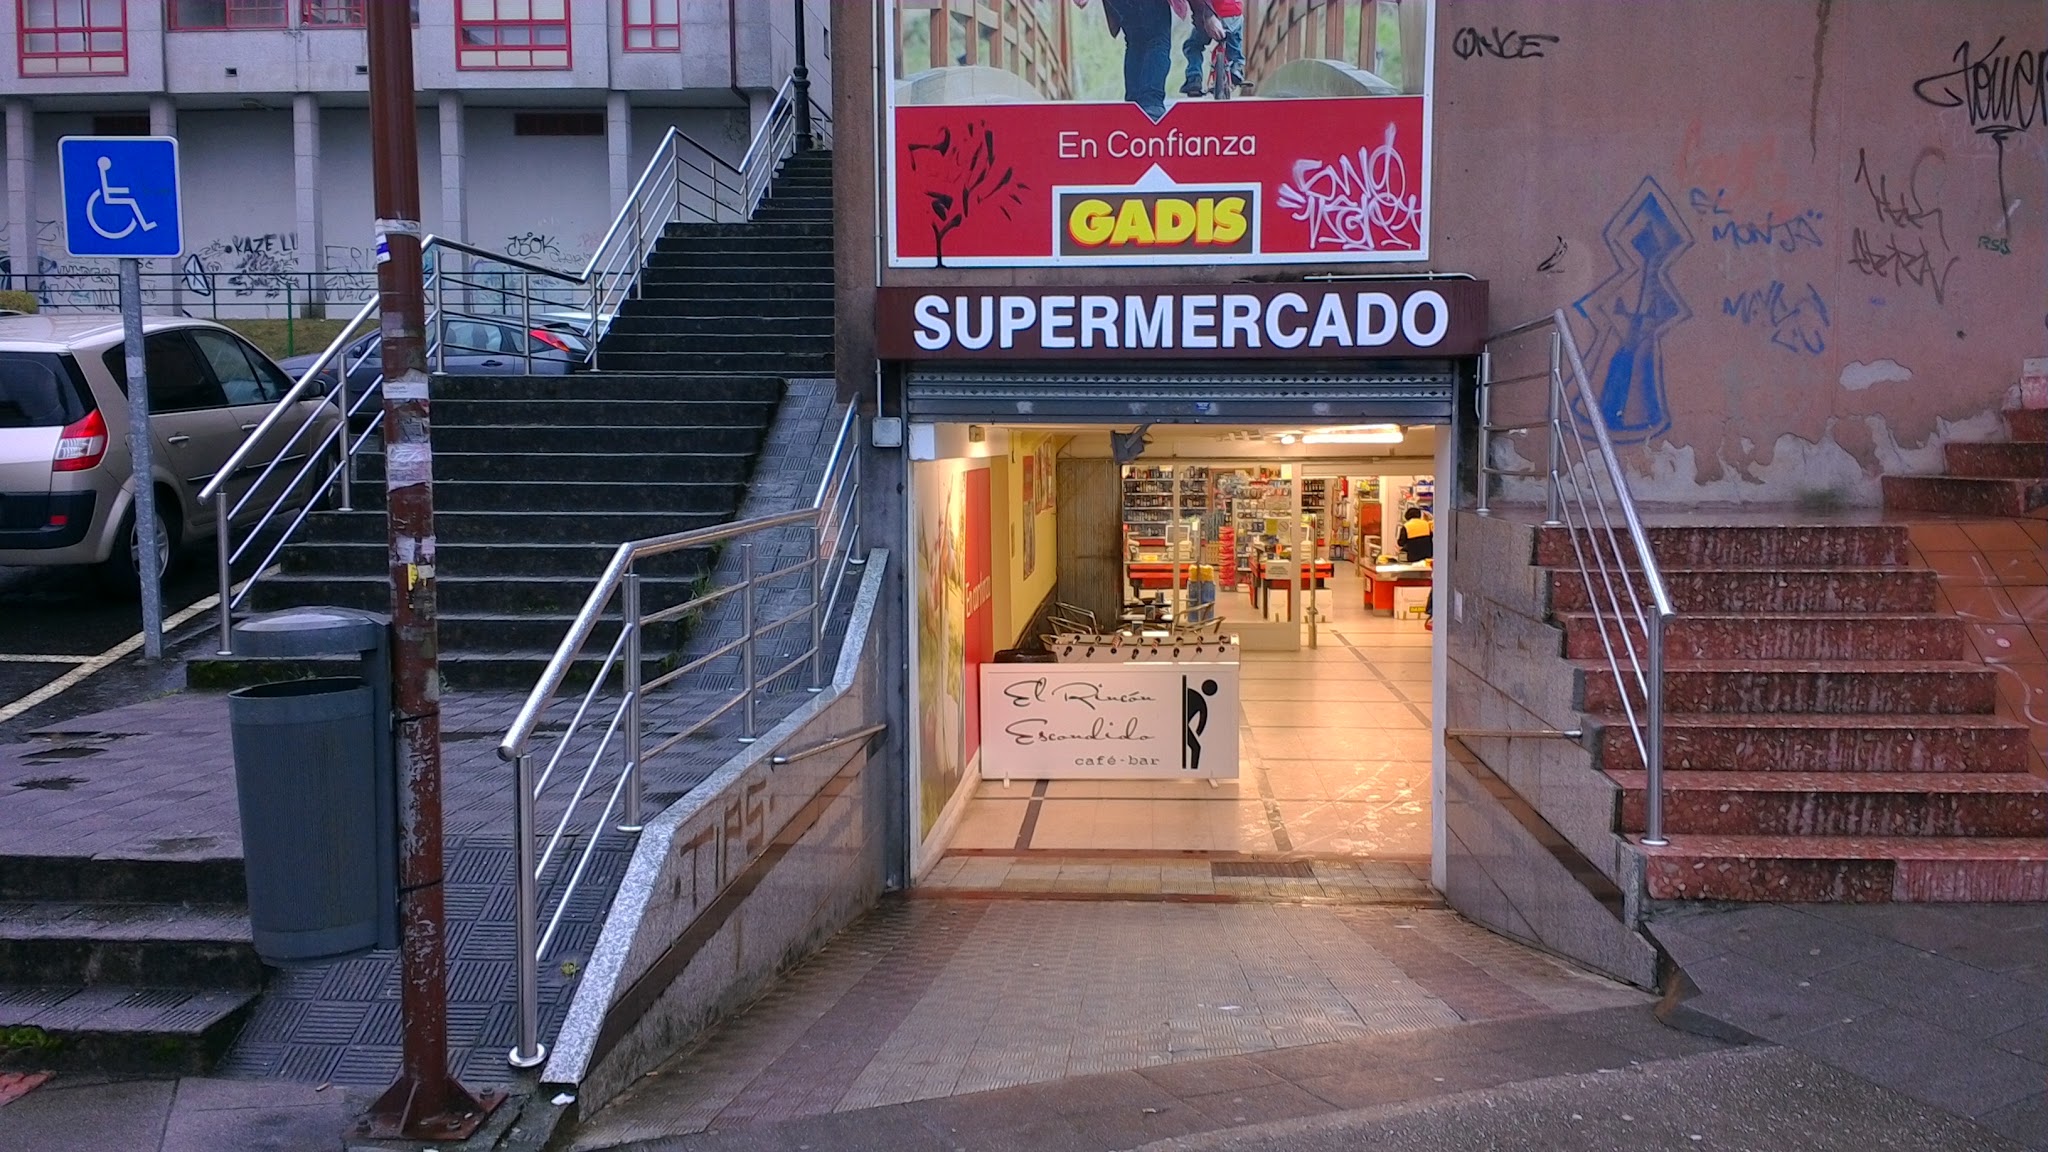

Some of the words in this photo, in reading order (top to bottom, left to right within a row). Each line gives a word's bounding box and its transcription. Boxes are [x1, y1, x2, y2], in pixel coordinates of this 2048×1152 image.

[1058, 131, 1098, 159] En
[1107, 128, 1256, 158] Confianza
[1068, 197, 1248, 248] GADIS
[913, 290, 1449, 350] SUPERMERCADO
[1003, 677, 1047, 707] El
[1051, 682, 1157, 711] Rincón
[1004, 716, 1156, 746] Escondido
